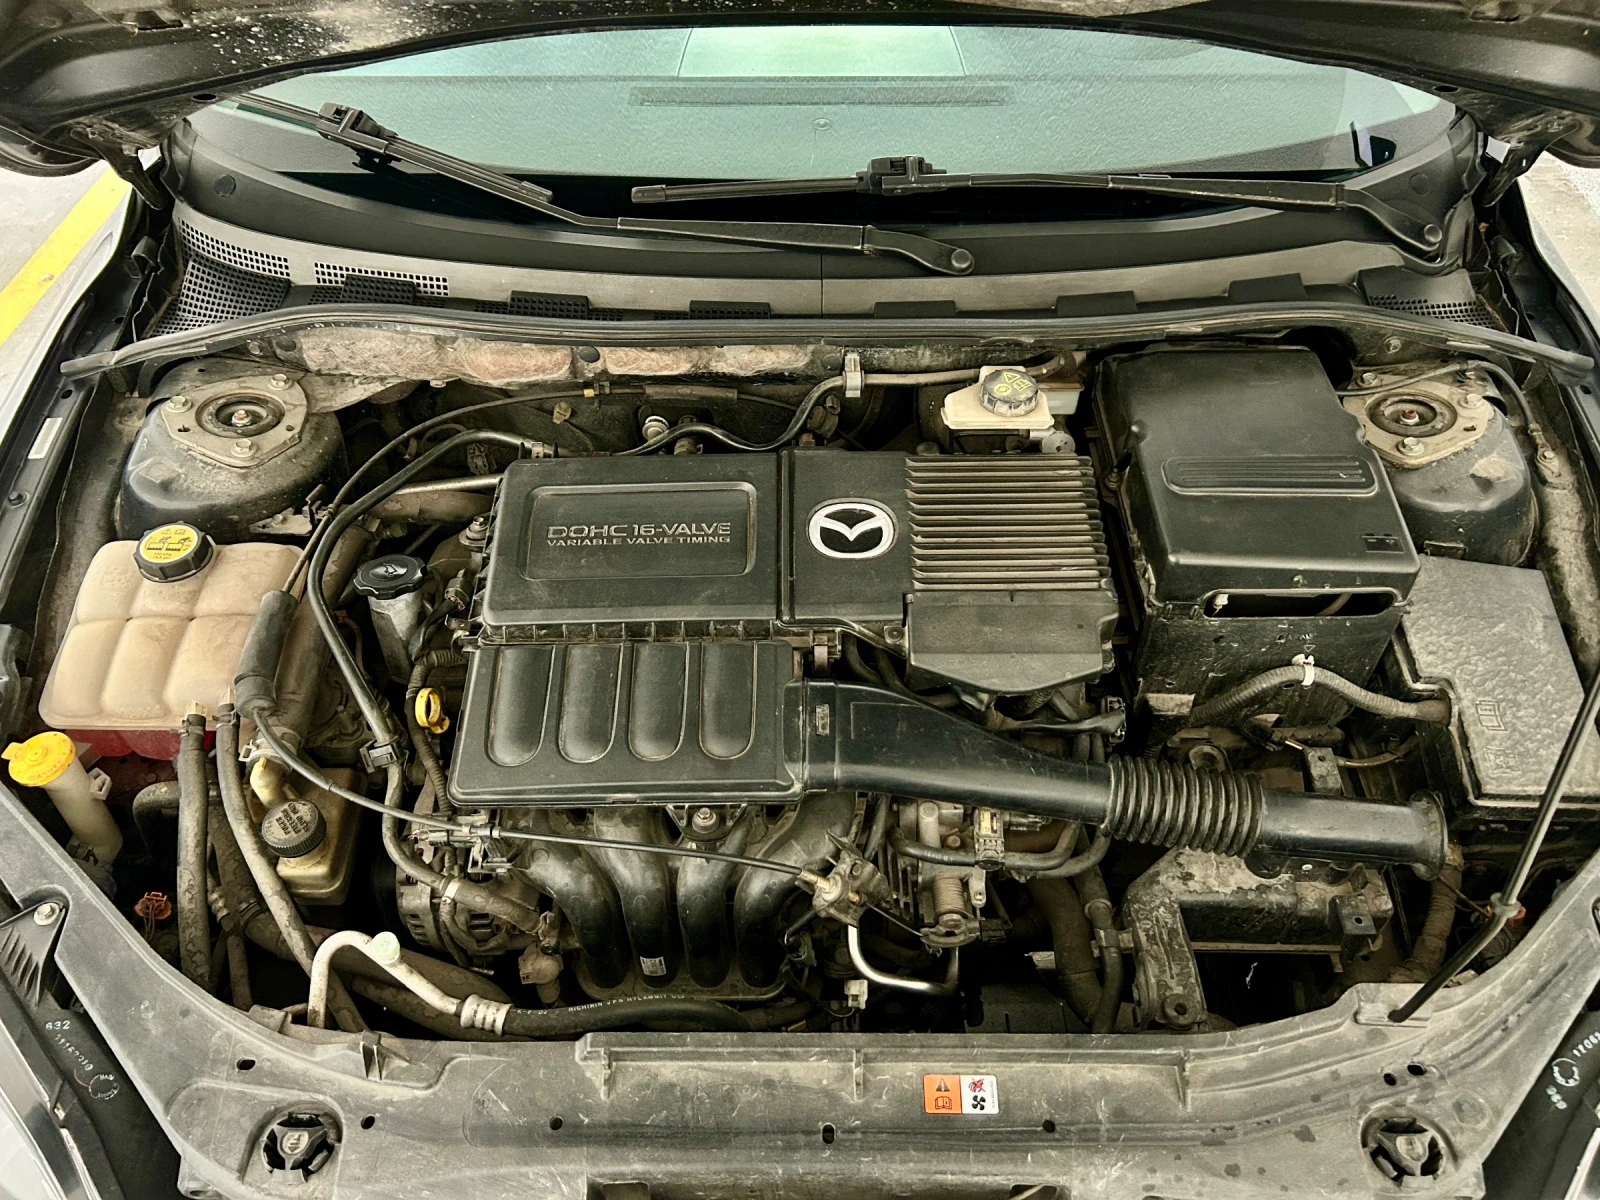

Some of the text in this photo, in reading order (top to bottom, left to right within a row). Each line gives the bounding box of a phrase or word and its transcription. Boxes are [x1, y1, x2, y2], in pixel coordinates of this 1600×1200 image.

[547, 522, 731, 538] DOHC 16-VALVE
[547, 535, 731, 547] VARIABLE VALVE TIMING
